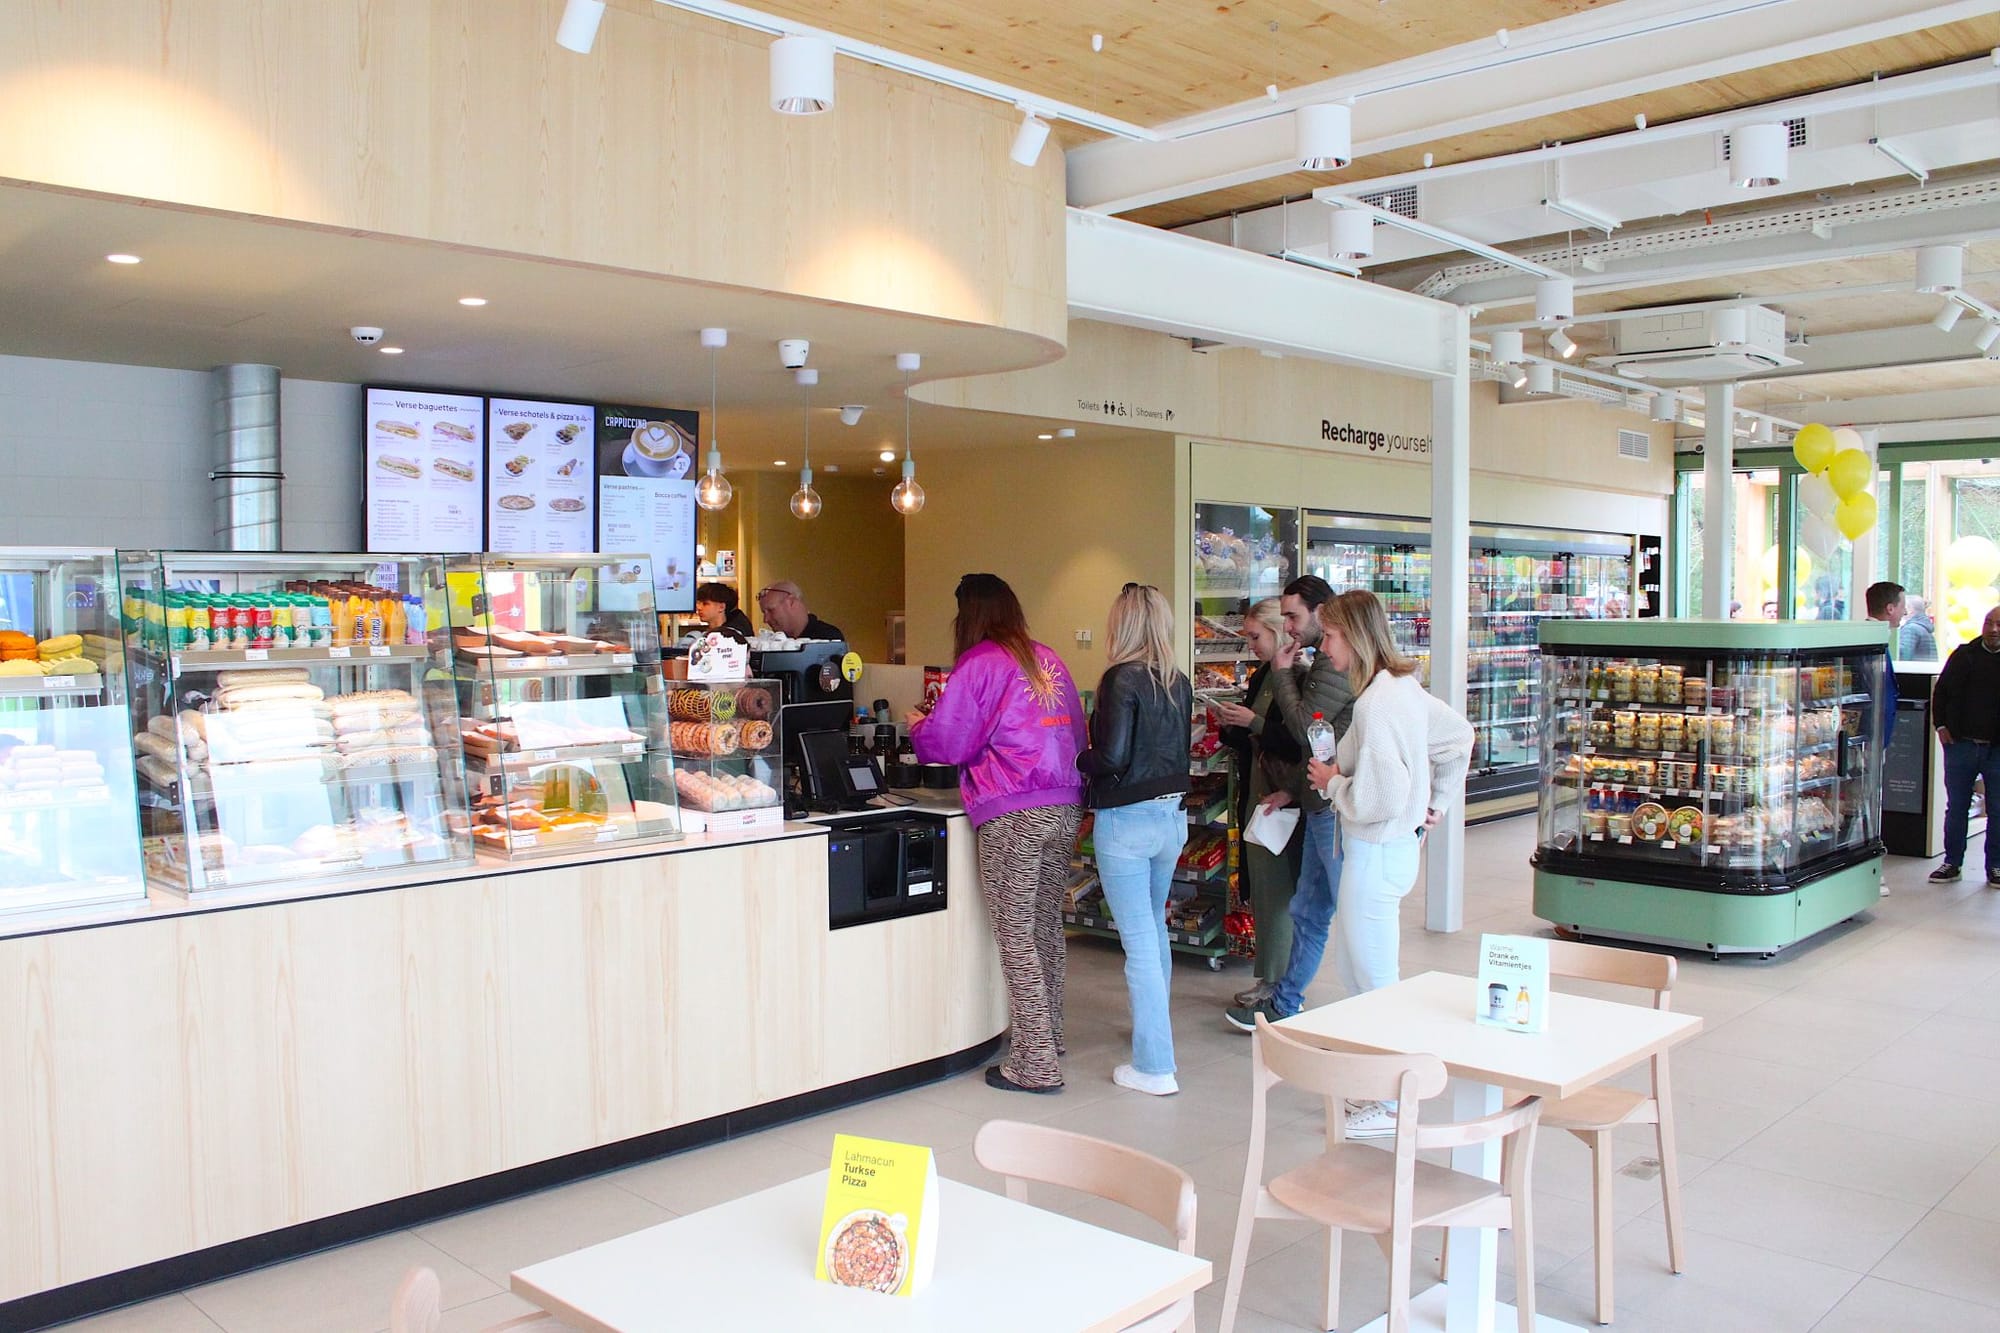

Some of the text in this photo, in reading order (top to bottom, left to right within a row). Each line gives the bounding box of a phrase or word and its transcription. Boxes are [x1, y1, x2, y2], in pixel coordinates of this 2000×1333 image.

[395, 400, 458, 413] Verse baguettes
[1077, 399, 1100, 411] Toilets
[498, 408, 519, 417] Verse
[520, 409, 549, 419] schotels
[1321, 419, 1385, 451] Recharge
[1489, 951, 1509, 959] Drank
[844, 1150, 895, 1167] Lahmacun
[844, 1162, 876, 1177] Turkse
[841, 1175, 867, 1188] Pizza
